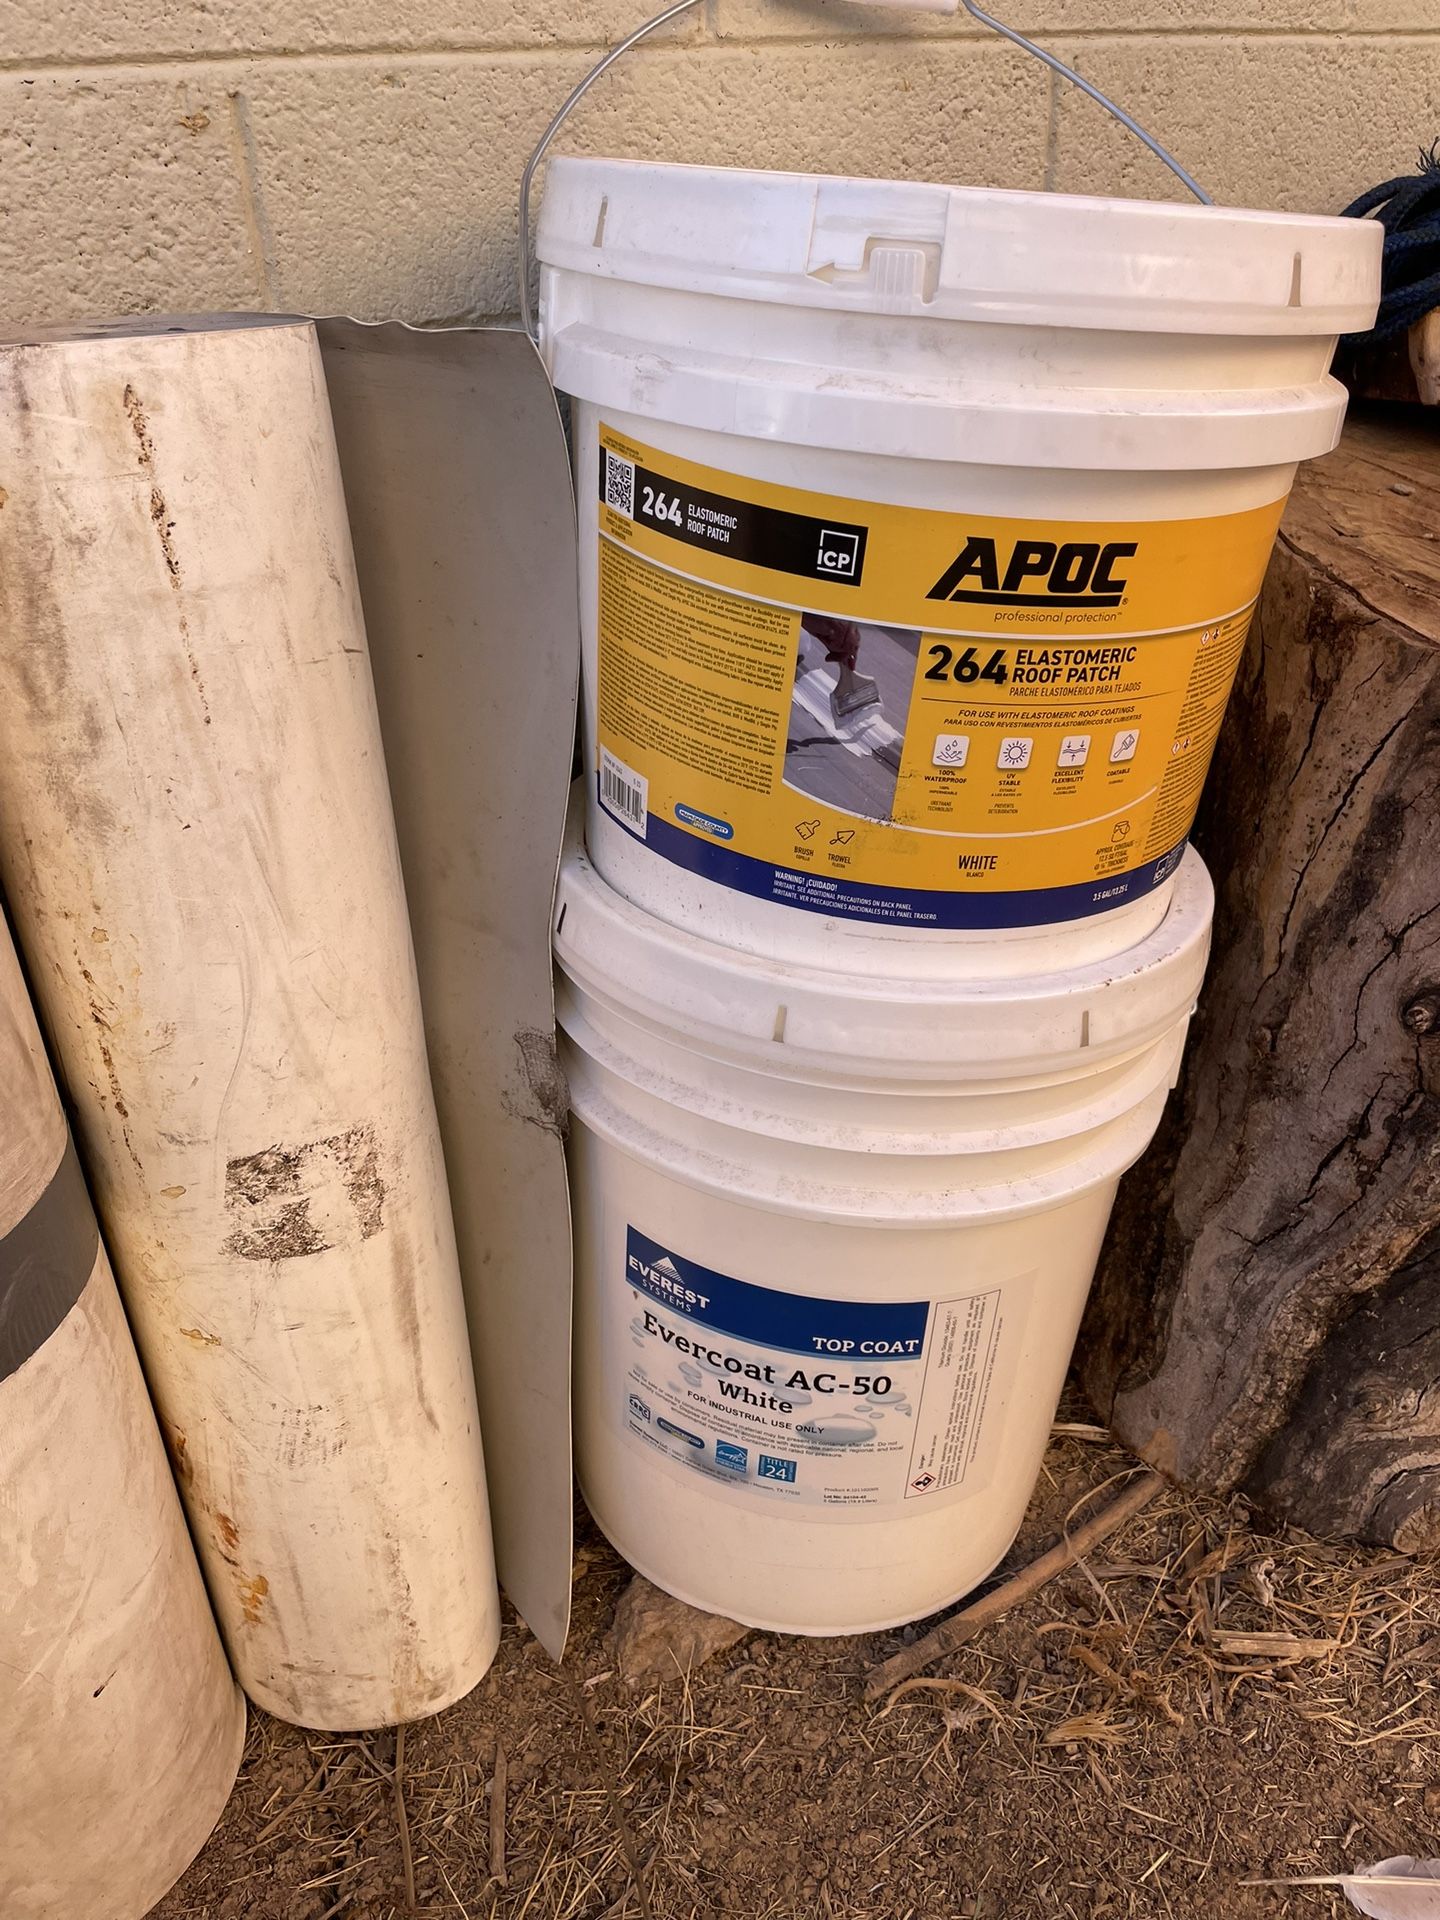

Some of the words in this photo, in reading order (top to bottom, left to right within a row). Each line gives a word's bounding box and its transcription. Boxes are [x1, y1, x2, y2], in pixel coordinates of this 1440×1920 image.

[642, 486, 683, 527] 264
[688, 503, 738, 530] ELASTOMERIC
[687, 519, 706, 535] ROOF
[707, 527, 730, 543] PATCH
[925, 536, 1138, 601] APOC
[994, 610, 1063, 623] professional
[925, 644, 1008, 685] 264
[1015, 646, 1137, 666] ELASTOMERIC
[1012, 667, 1063, 683] ROOF
[1066, 665, 1121, 683] PATCH
[1009, 686, 1039, 697] PARCHE
[1095, 685, 1113, 695] PARA
[958, 709, 977, 718] FOR
[978, 710, 996, 719] USE
[997, 711, 1019, 720] WITH
[1020, 711, 1077, 720] ELASTOMERIC
[1078, 709, 1099, 718] ROOF
[1100, 705, 1135, 716] COATINGS
[943, 718, 963, 726] PARA
[963, 719, 979, 727] USO
[979, 720, 998, 728] CON
[924, 775, 967, 784] WATERPROOF
[793, 845, 815, 857] BRUSH
[828, 853, 851, 865] TROWEL
[958, 854, 998, 870] WHITE
[774, 870, 805, 885] WARNING!
[806, 888, 836, 900] ADDITIONAL
[836, 894, 871, 907] PRECAUTIONS
[872, 899, 880, 907] ON
[880, 900, 895, 909] BACK
[809, 897, 847, 910] PRECAUCIONES
[848, 904, 881, 915] ADICIONALES
[881, 908, 890, 917] EN
[889, 909, 896, 917] EL
[896, 910, 913, 919] PANEL
[628, 1253, 710, 1310] EVEREST
[641, 1277, 692, 1313] SYSTEMS
[643, 1310, 776, 1385] Evercoat
[785, 1373, 892, 1395] AC-50
[812, 1336, 855, 1353] TOP
[859, 1339, 919, 1354] COAT
[717, 1379, 793, 1414] White
[687, 1390, 707, 1405] FOR
[709, 1400, 768, 1425] INDUSTRIAL
[771, 1419, 792, 1430] USE
[795, 1424, 825, 1434] ONLY
[766, 1457, 789, 1468] TITLE
[765, 1465, 787, 1480] 24
